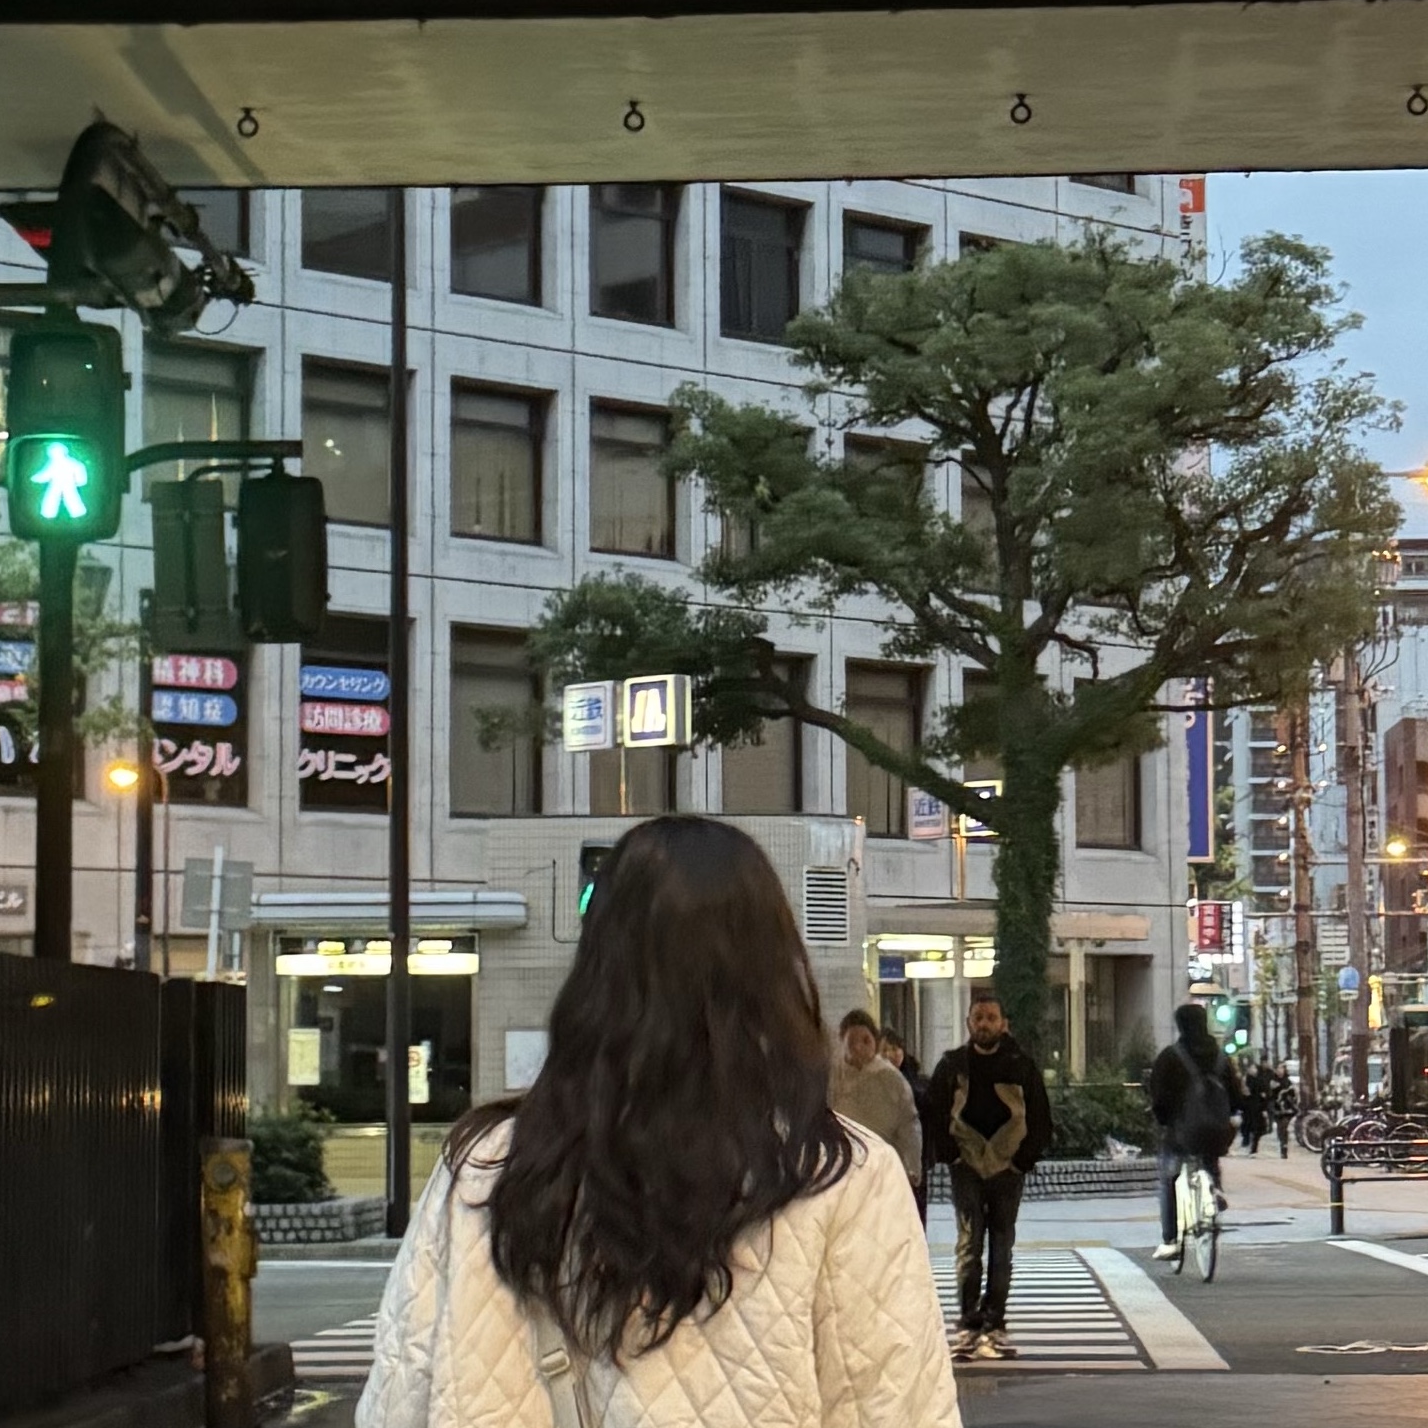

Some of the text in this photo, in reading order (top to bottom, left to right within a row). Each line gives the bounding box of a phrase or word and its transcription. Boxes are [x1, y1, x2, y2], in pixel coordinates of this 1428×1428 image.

[295, 748, 392, 784] クリニック
